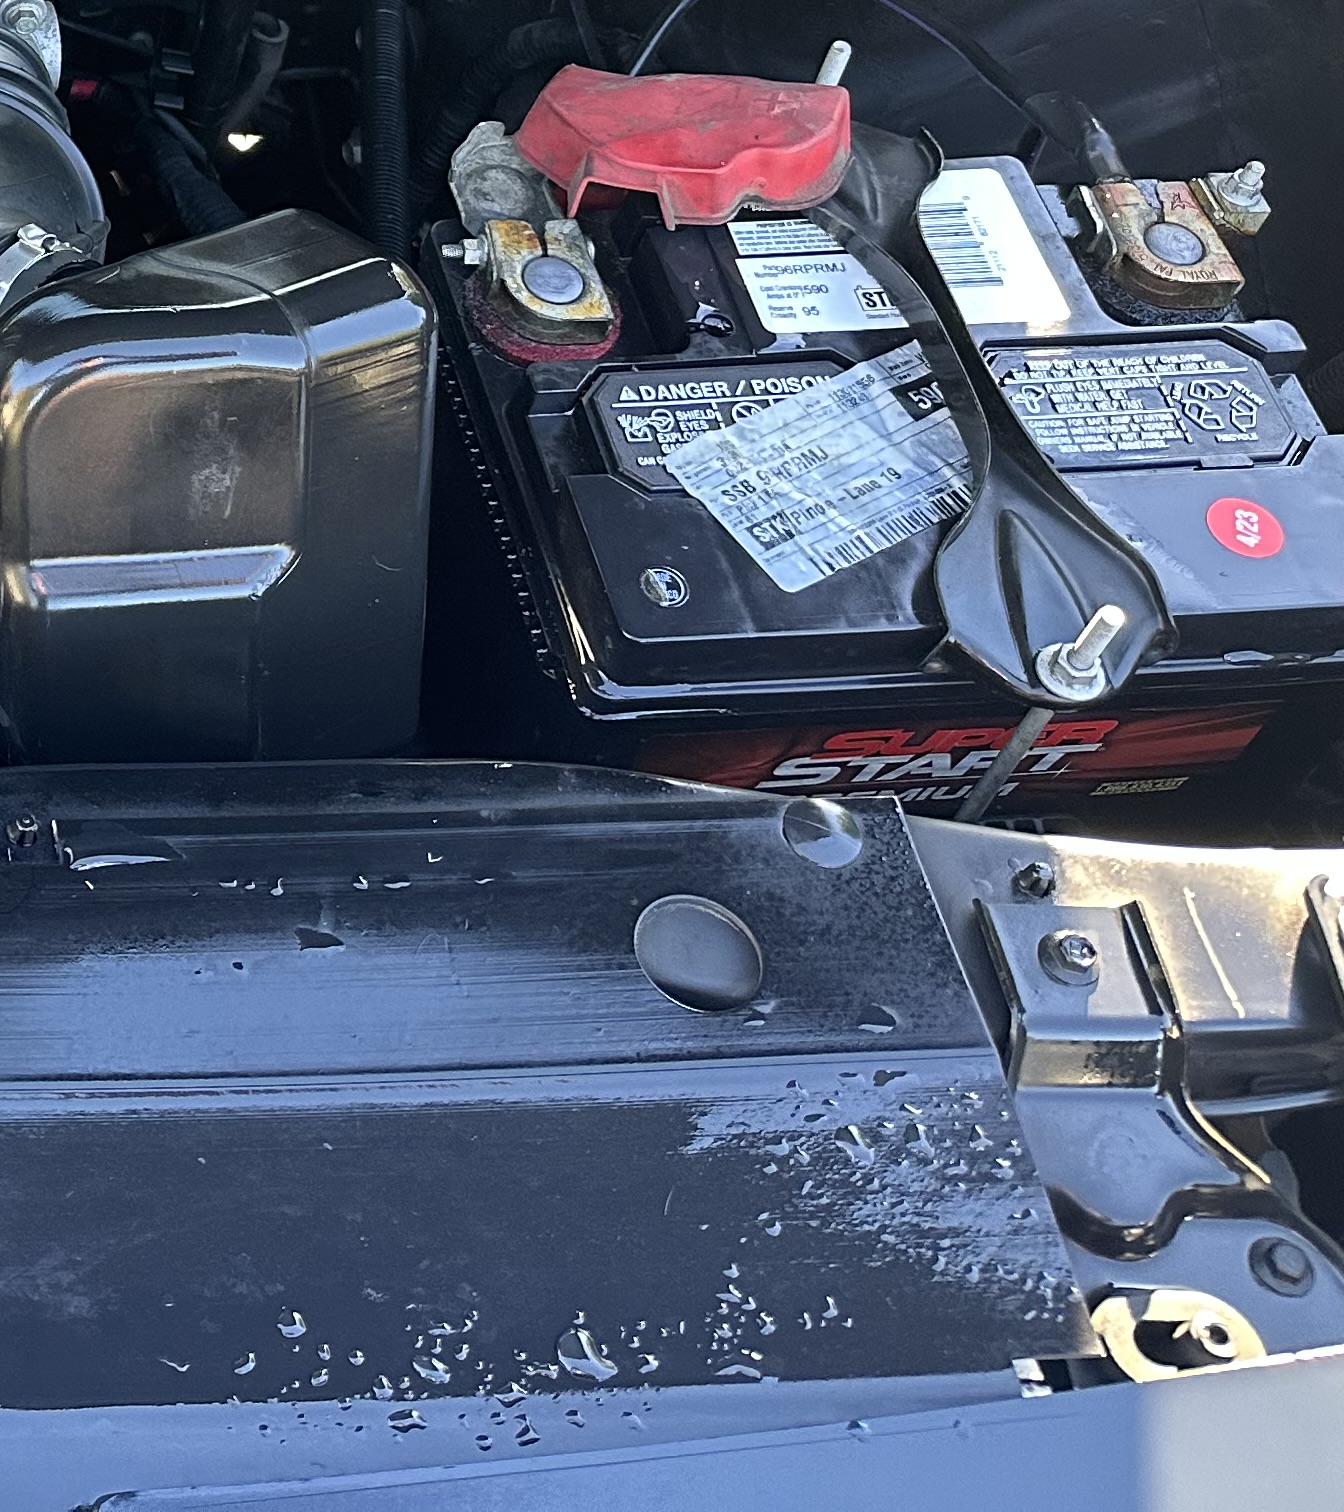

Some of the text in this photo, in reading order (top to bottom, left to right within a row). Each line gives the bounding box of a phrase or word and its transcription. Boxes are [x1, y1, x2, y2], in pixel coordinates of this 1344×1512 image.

[776, 262, 847, 275] 96RPRMJ
[802, 284, 829, 295] 590
[801, 306, 820, 316] 95
[638, 380, 732, 402] DANGER
[734, 378, 747, 396] /
[675, 408, 715, 421] SHIELD
[679, 420, 710, 431] EYES
[1234, 508, 1262, 548] 4/23
